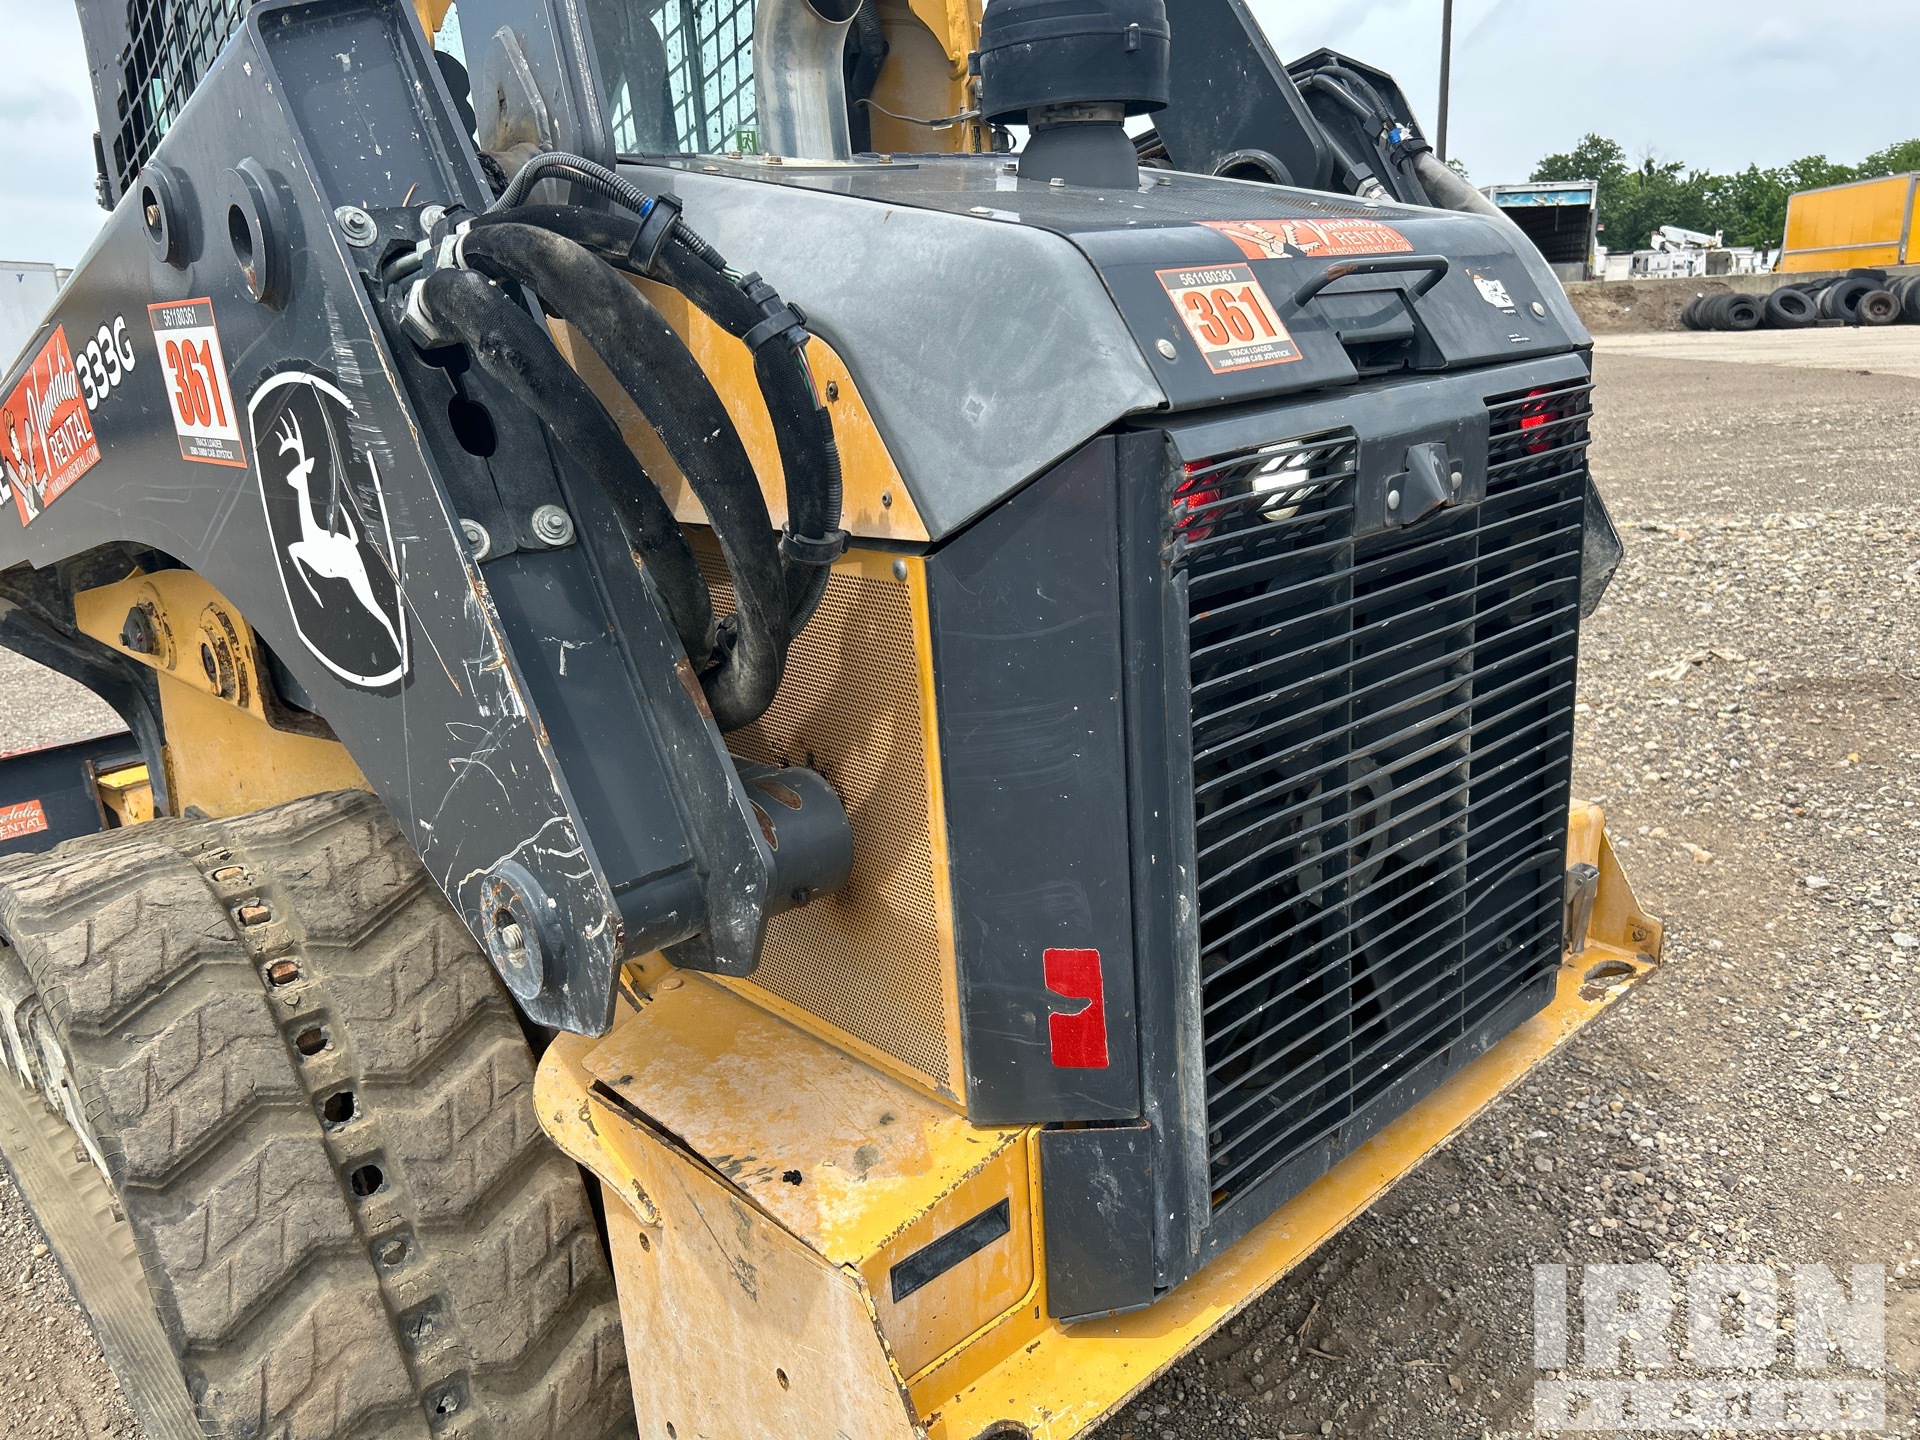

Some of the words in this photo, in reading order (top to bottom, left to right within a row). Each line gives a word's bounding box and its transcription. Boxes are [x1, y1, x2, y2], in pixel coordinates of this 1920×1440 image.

[1331, 230, 1404, 246] RENTAL
[1326, 243, 1413, 255] VANDALIARENTAL.COM
[1179, 269, 1237, 286] 561180361
[163, 306, 198, 327] 561180361
[1183, 286, 1278, 346] 361
[1228, 348, 1250, 357] TRACK
[1249, 344, 1274, 354] LOADER
[1263, 350, 1291, 360] JOYSTICK
[75, 315, 136, 411] 333G
[165, 338, 228, 428] 361
[26, 337, 79, 478] Vandalia
[49, 406, 93, 470] RENTAL
[50, 443, 100, 497] VANDALIARENTAL.COM
[0, 817, 45, 836] ENTAL
